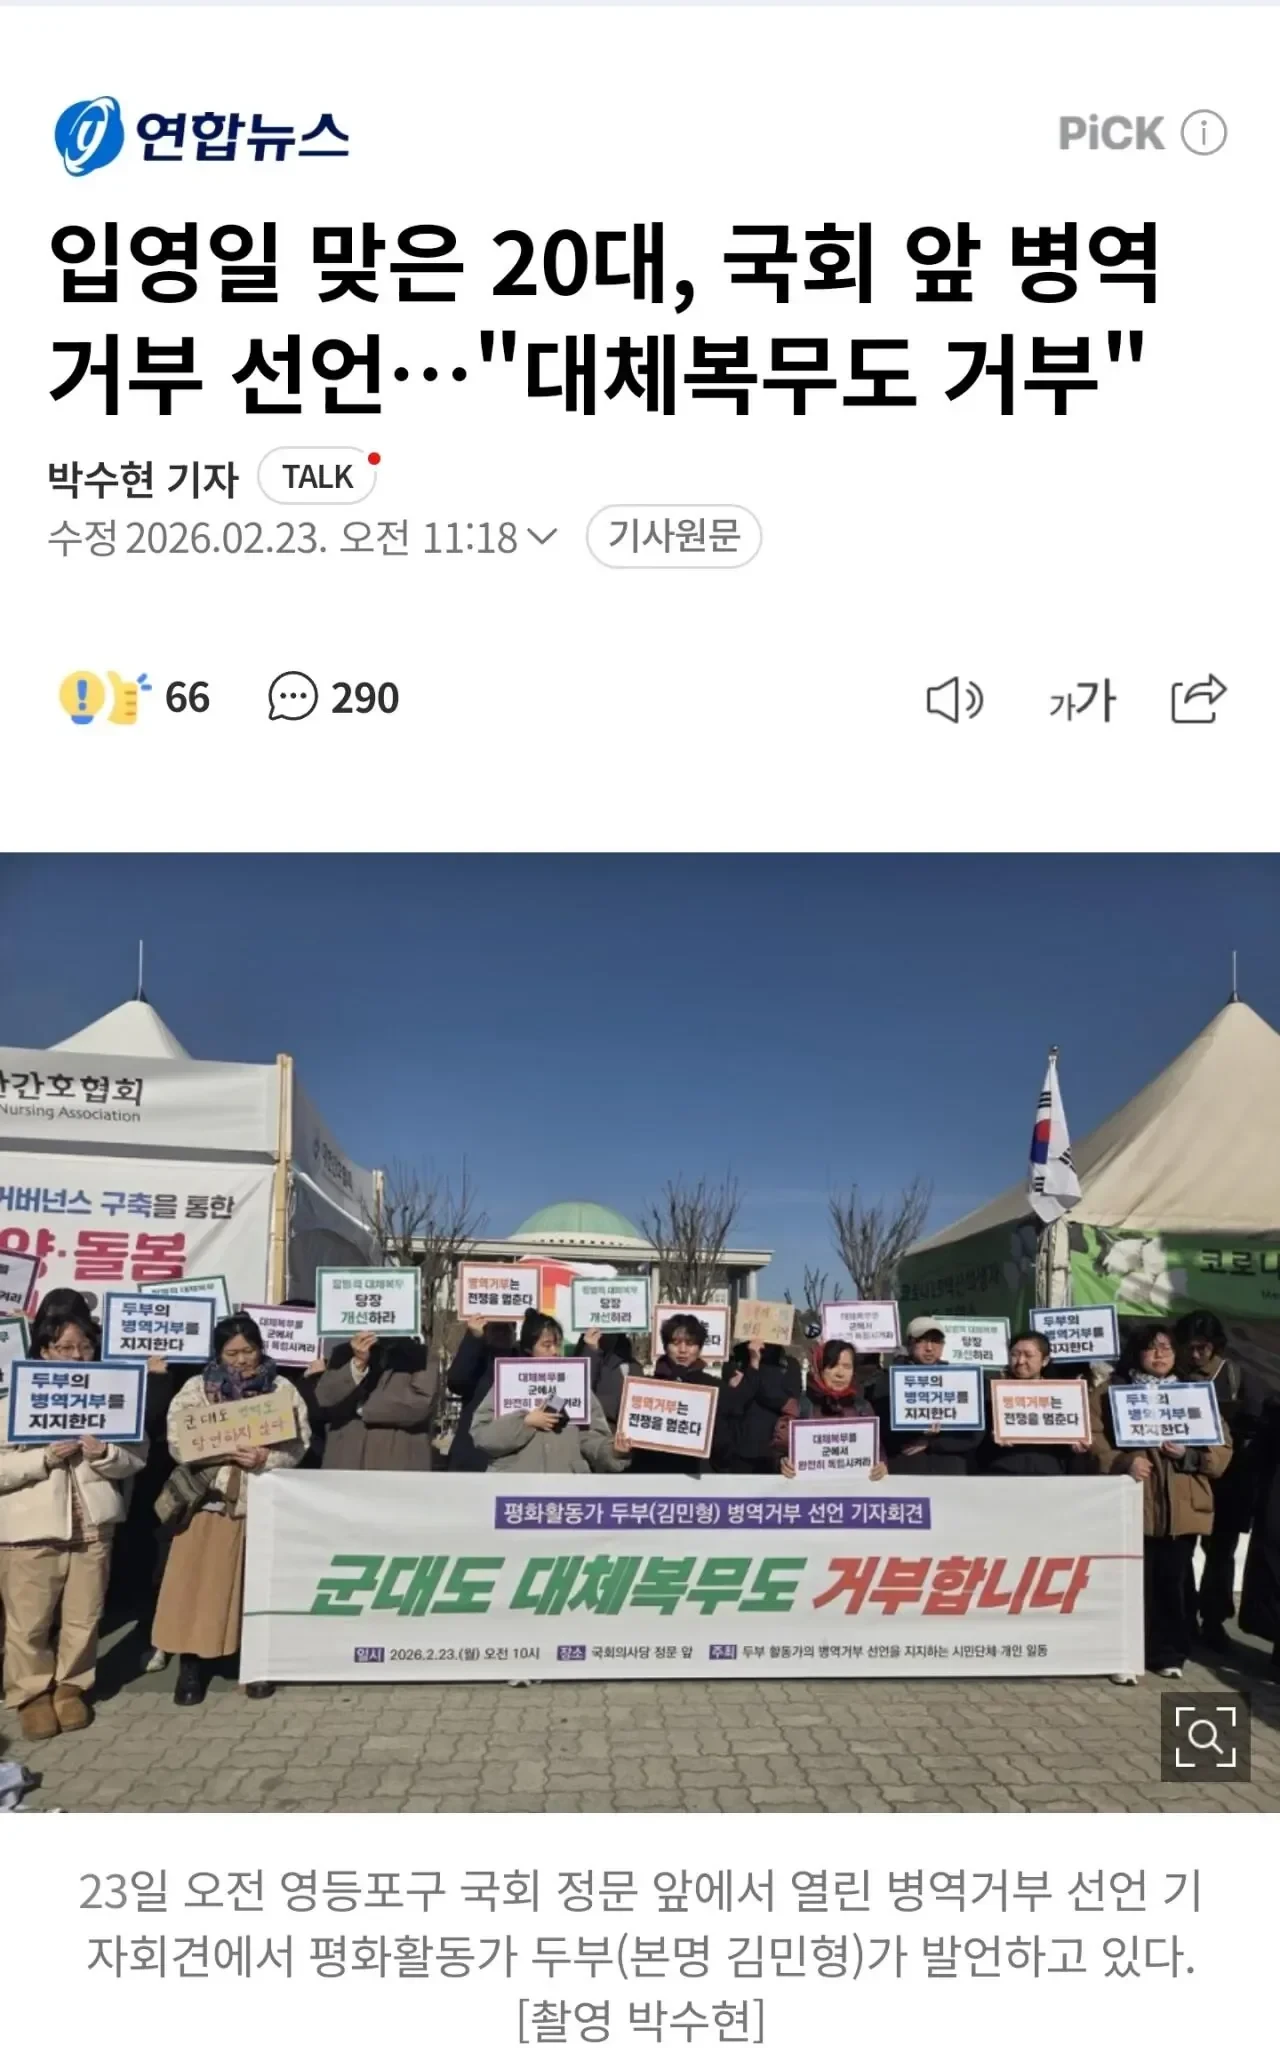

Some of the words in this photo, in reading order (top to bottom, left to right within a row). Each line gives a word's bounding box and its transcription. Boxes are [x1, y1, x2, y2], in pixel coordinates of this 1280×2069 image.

[0, 1103, 55, 1119] Nursing
[58, 1106, 141, 1122] Association
[101, 1192, 178, 1219] 구축을
[185, 1195, 235, 1220] 통한
[355, 1294, 382, 1308] 당장
[121, 1302, 170, 1317] 두부의
[341, 1311, 397, 1325] 개선하라
[590, 1311, 632, 1324] 개선하라
[1044, 1314, 1080, 1327] 두부의
[121, 1319, 200, 1336] 병역거부를
[120, 1337, 184, 1351] 지지한다
[31, 1373, 89, 1389] 두부의
[904, 1375, 943, 1387] 두부의
[31, 1393, 125, 1410] 병역거부를
[904, 1391, 969, 1404] 병역거부를
[904, 1406, 957, 1420] 지지한다
[1004, 1412, 1039, 1426] 전쟁을
[1042, 1412, 1080, 1426] 멈춘다
[29, 1413, 106, 1429] 지지한다
[628, 1412, 663, 1431] 전쟁을
[666, 1417, 702, 1437] 멈춘다
[504, 1502, 604, 1525] 평화활동가
[610, 1502, 720, 1525] 두부(김민형)
[727, 1503, 802, 1524] 병역거부
[808, 1503, 844, 1524] 선언
[851, 1503, 924, 1524] 기자회견
[309, 1554, 505, 1617] 군대도
[509, 1554, 808, 1616] 대체복무도
[812, 1554, 1090, 1616] 거부합니다
[356, 1648, 382, 1662] 일시
[484, 1647, 509, 1660] 오전
[513, 1647, 540, 1660] 10시
[592, 1646, 651, 1660] 국회의사당
[655, 1646, 678, 1659] 정문
[743, 1645, 765, 1659] 두부
[770, 1645, 815, 1659] 활동가의
[819, 1645, 863, 1659] 병역거부
[867, 1645, 900, 1658] 선언을
[904, 1645, 949, 1658] 지지하는
[1026, 1644, 1049, 1657] 일동
